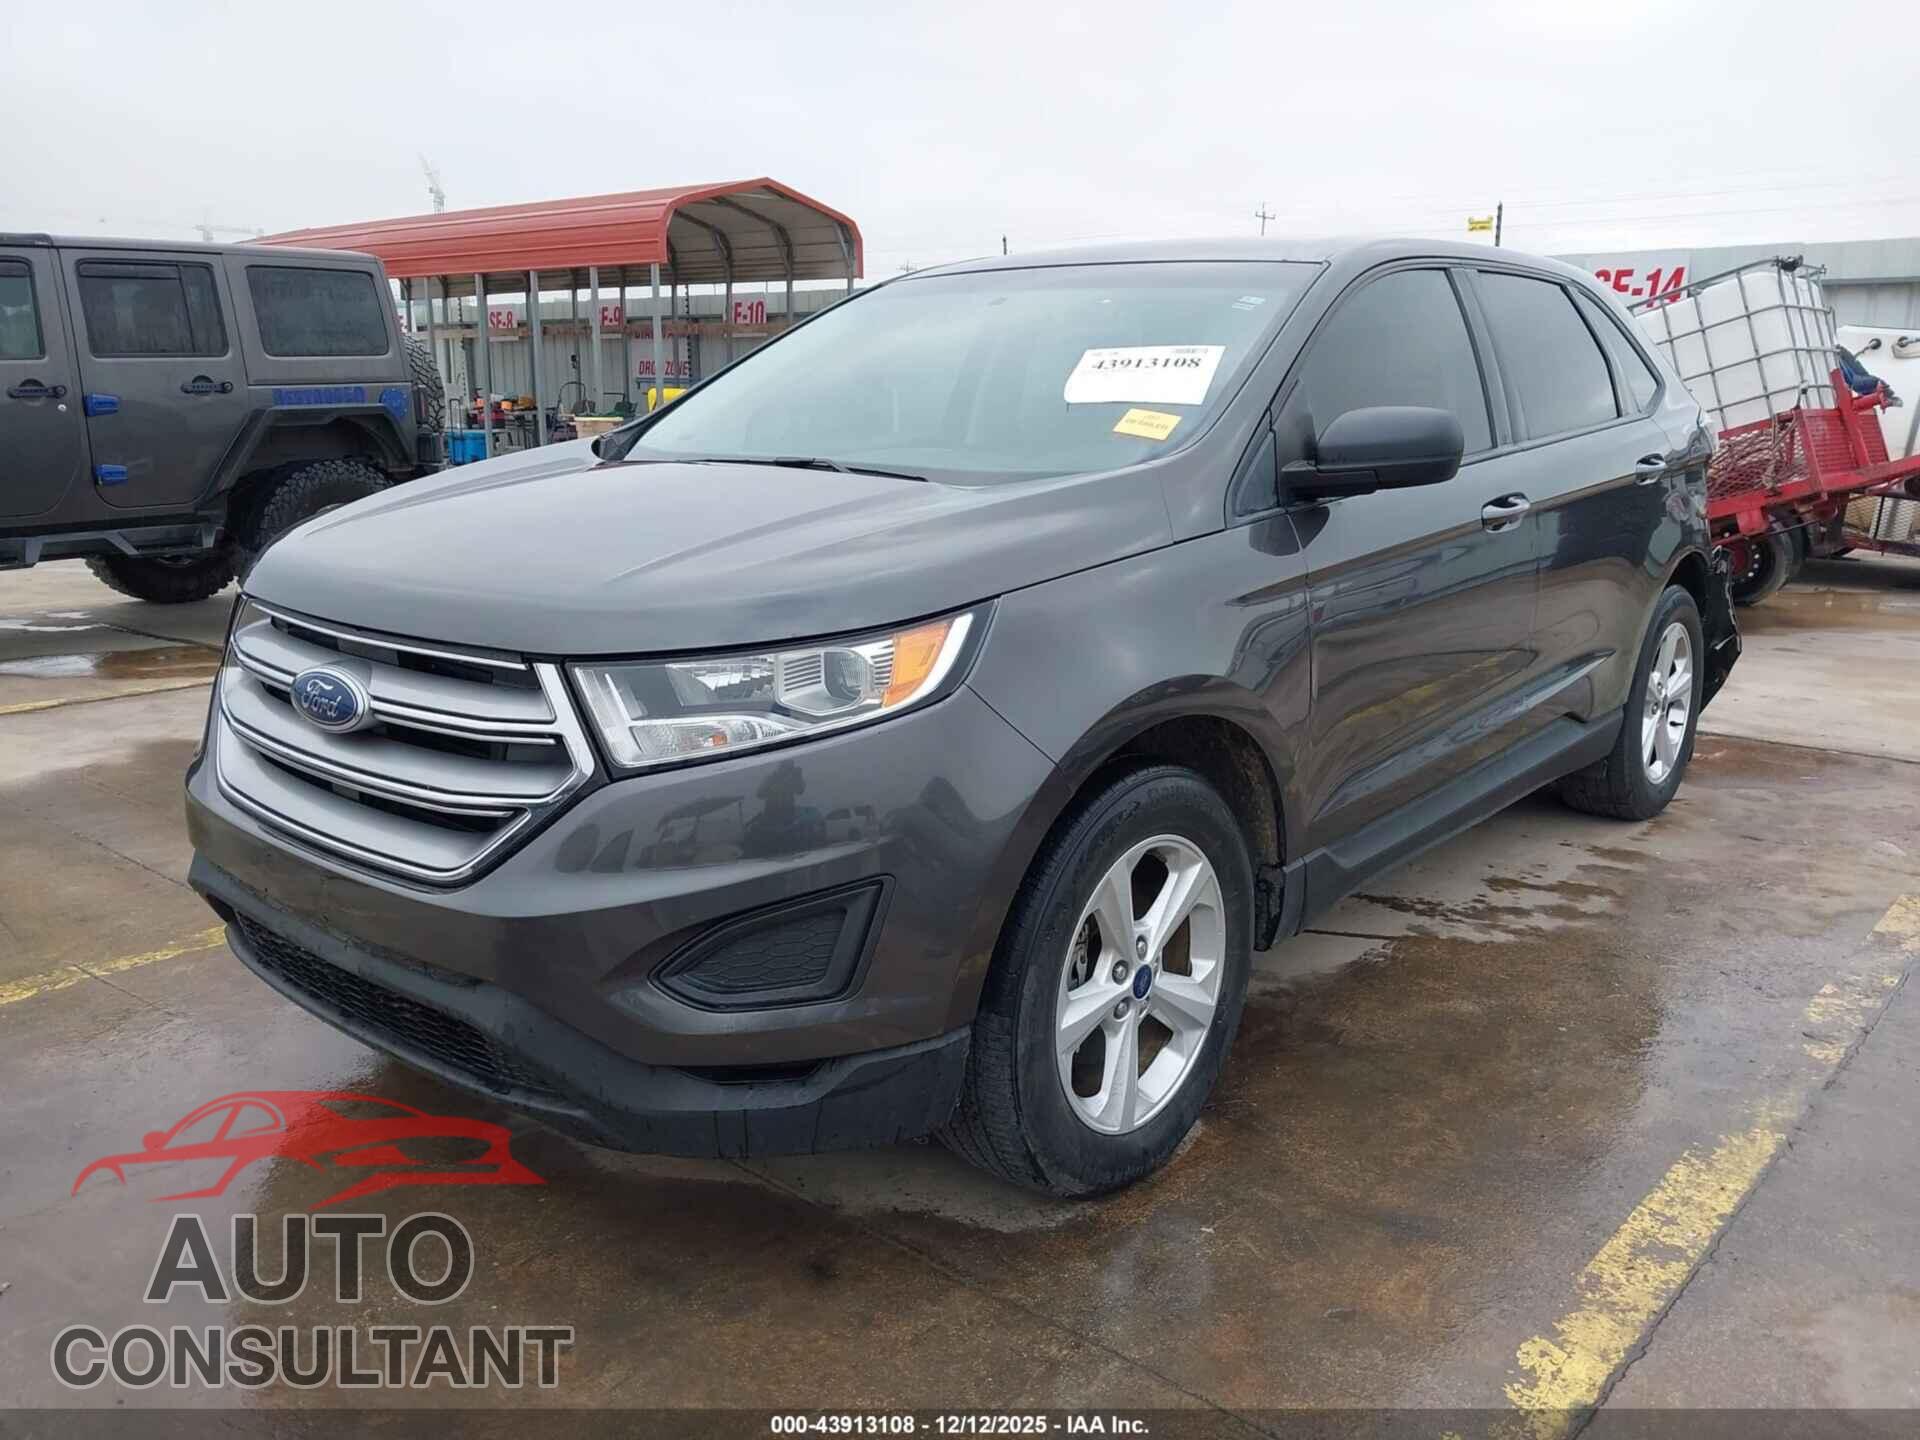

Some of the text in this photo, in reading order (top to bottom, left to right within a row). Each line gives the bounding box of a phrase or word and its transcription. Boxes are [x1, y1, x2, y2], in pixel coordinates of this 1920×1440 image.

[639, 361, 657, 376] DRO
[1092, 357, 1201, 370] 43913108
[301, 679, 342, 718] Ford
